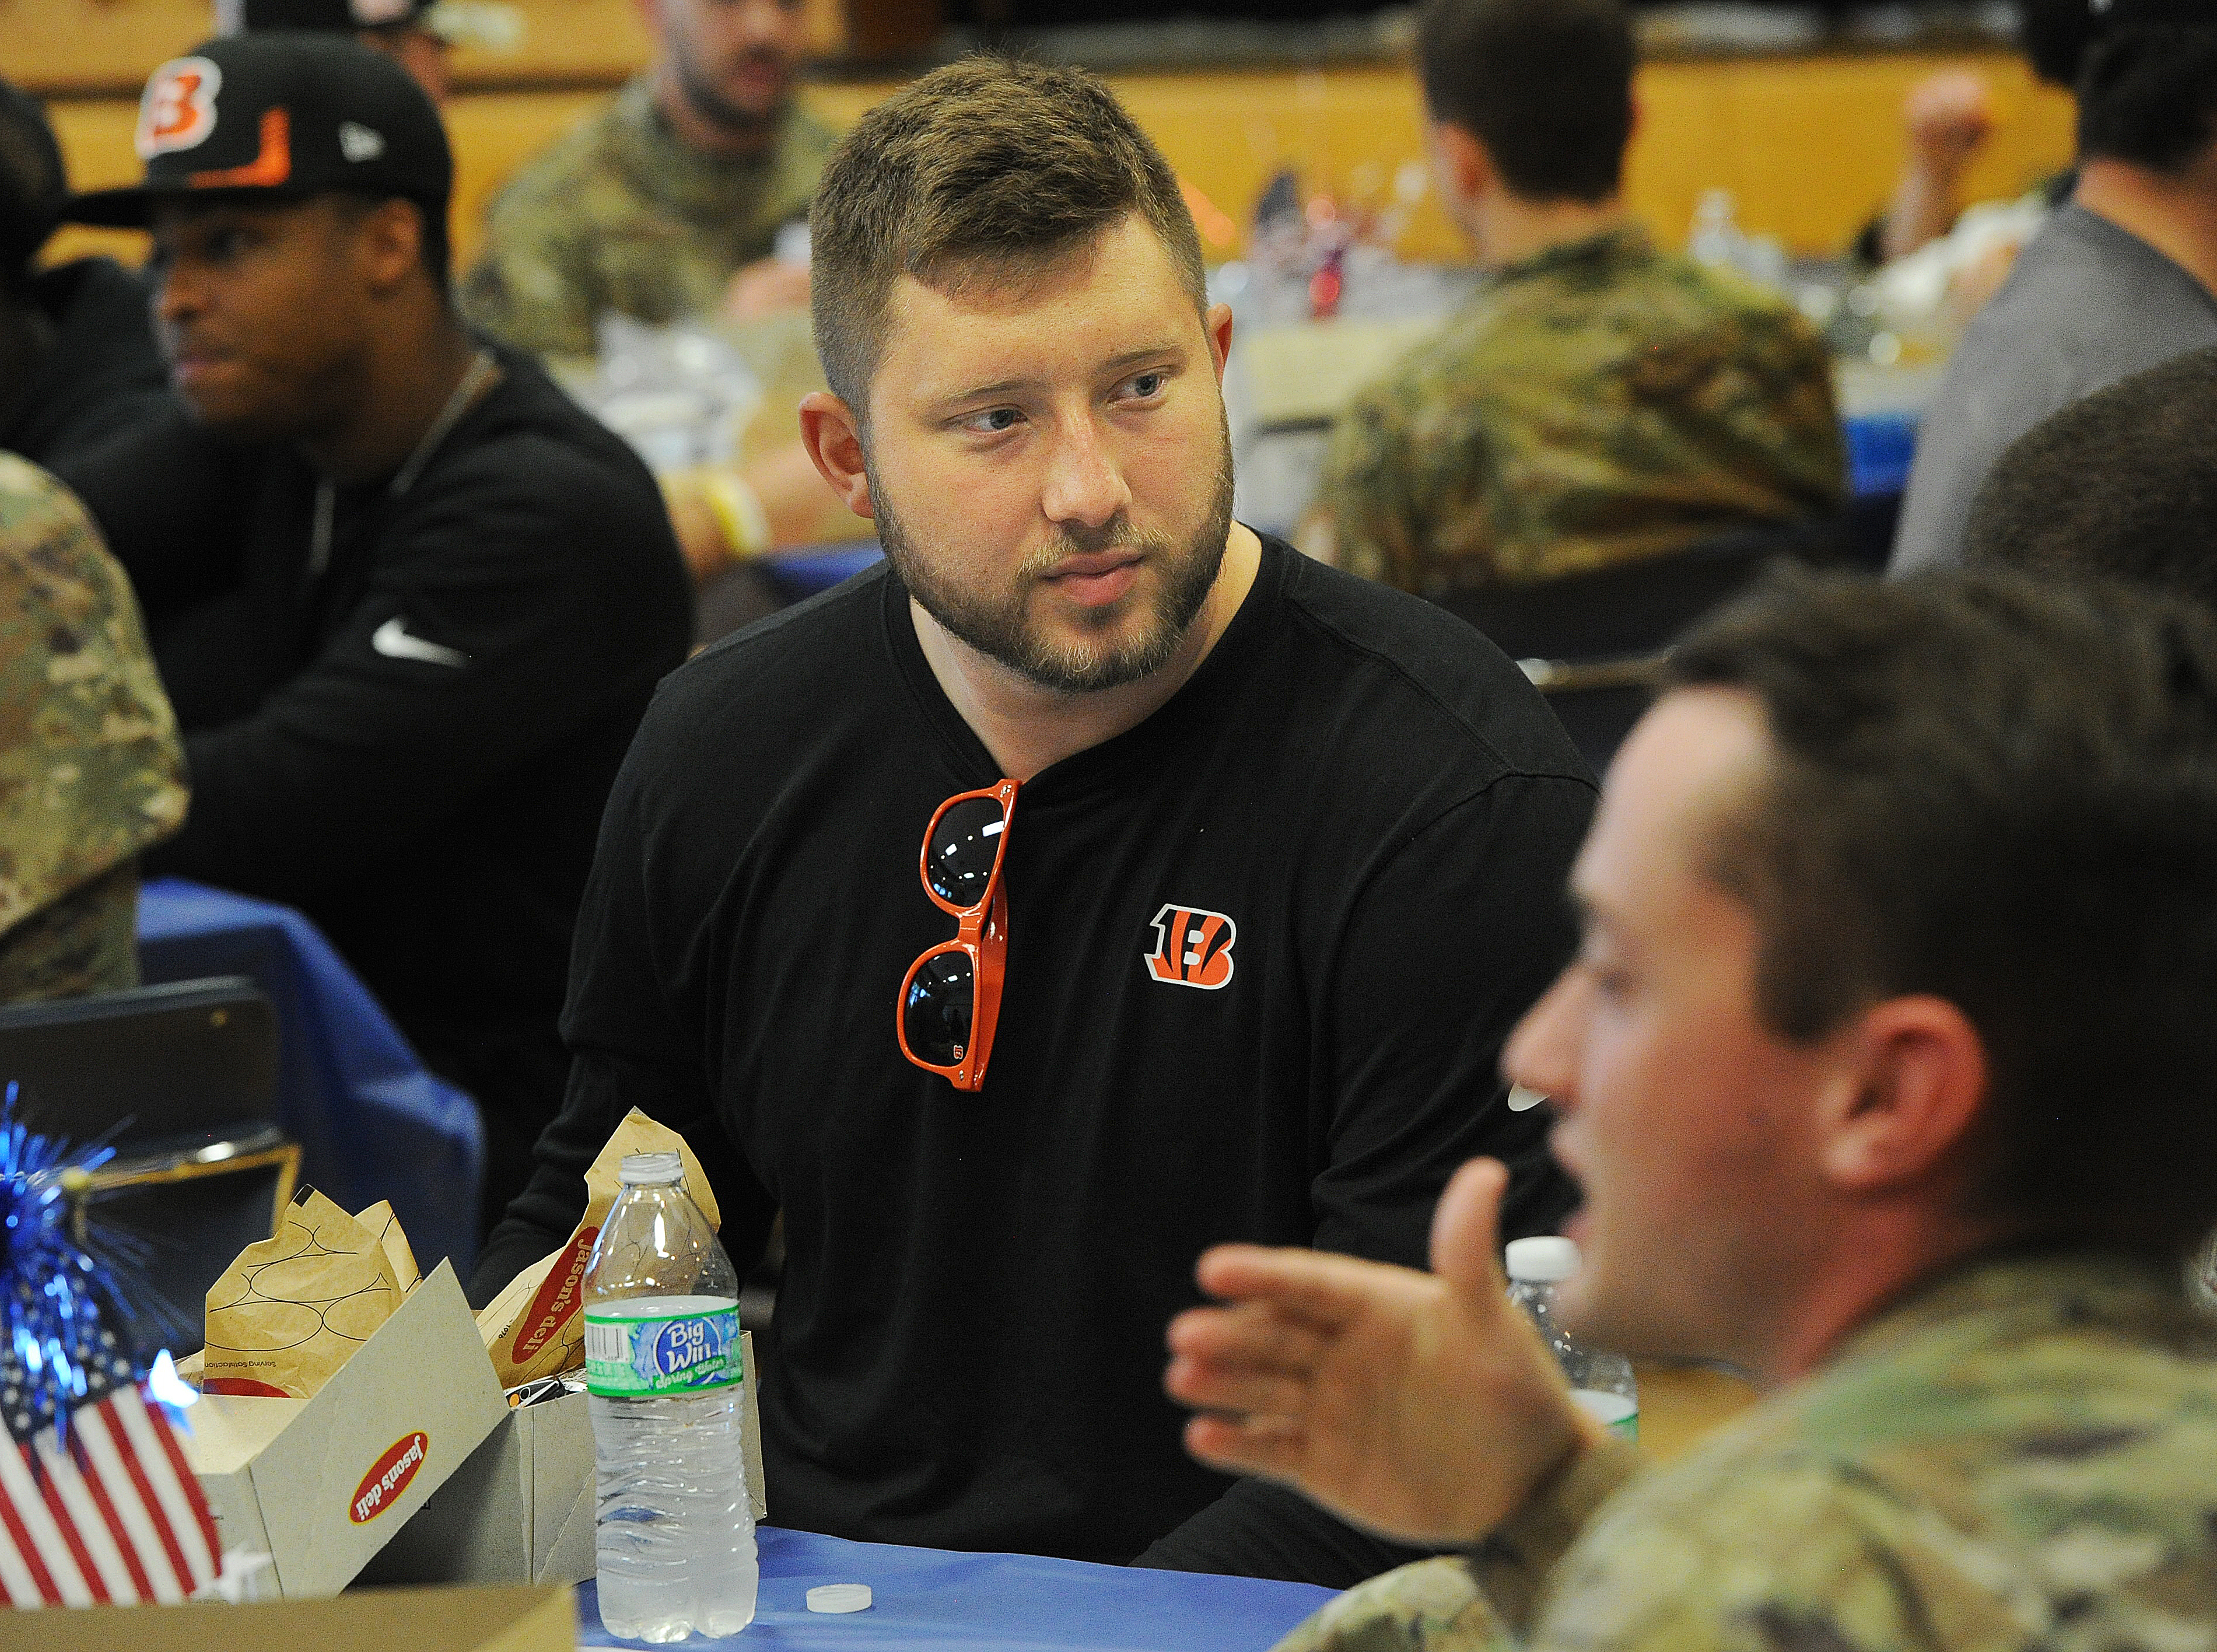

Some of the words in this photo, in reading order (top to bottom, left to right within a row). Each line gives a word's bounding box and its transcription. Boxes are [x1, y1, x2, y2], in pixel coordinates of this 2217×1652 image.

[1143, 904, 1237, 990] B
[551, 1238, 593, 1312] Jason's
[523, 1315, 556, 1350] deli
[667, 1321, 704, 1348] Big
[381, 1434, 423, 1492] Jason's
[356, 1483, 383, 1521] deli
